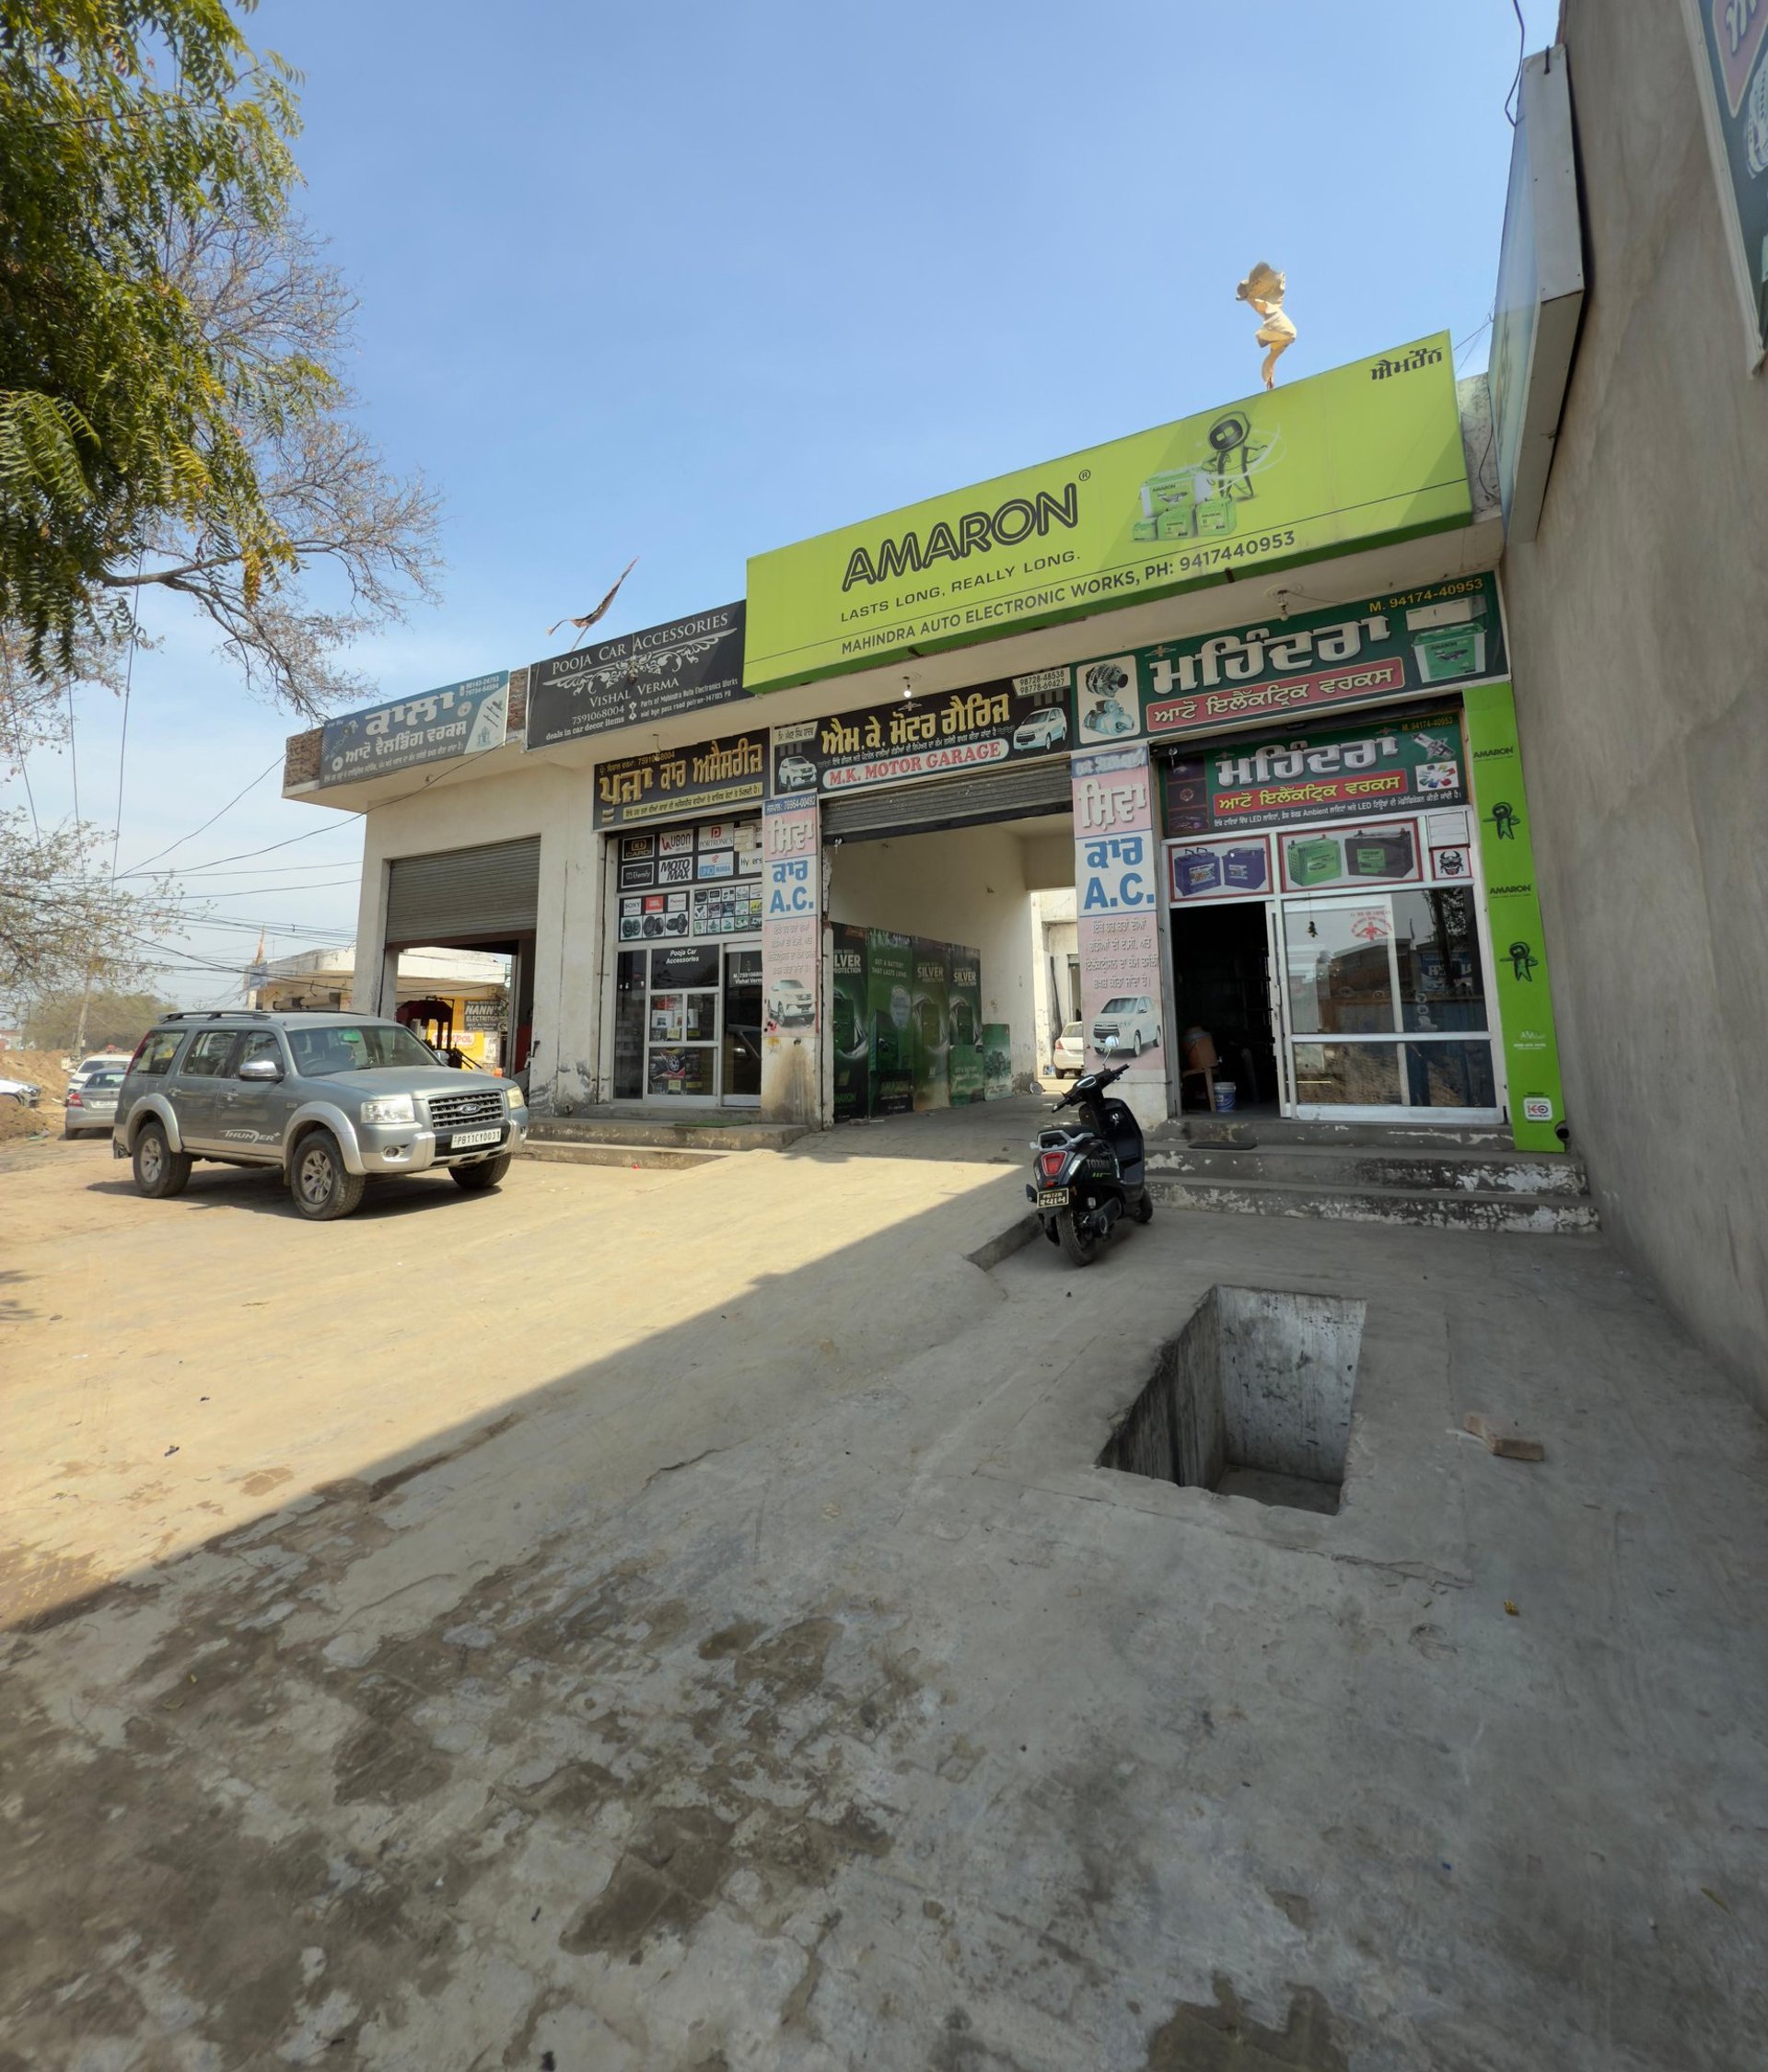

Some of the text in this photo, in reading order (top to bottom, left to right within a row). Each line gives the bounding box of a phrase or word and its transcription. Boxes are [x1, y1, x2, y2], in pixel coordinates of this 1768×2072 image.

[842, 483, 1078, 592] AMARON
[841, 550, 1081, 623] LASTS LONG, REALLY LONG.
[842, 530, 1296, 655] MAHINDRA AUTO ELECTRONIC WORKS, PH: 9417440953
[1369, 578, 1483, 613] M. 94174-40953
[552, 612, 728, 675] POOJA CAR ACCESSORIES
[1149, 615, 1391, 695] ਮਹਿੰਦਰਾ
[589, 678, 680, 708] VISHAL VERMA
[1018, 670, 1065, 687] 98728-48538
[1018, 678, 1065, 694] 98778-69427
[1154, 699, 1197, 723] ਆਟੋ
[1319, 667, 1394, 694] ਵਰਕਸ
[545, 716, 625, 741] deals in car decor items
[572, 704, 625, 725] 7591068004
[890, 711, 936, 745] ਮੋਟਰ
[345, 739, 371, 763] ਆਟੋ
[426, 721, 468, 743] ਵਰਕਸ
[1473, 746, 1514, 760] AMARON
[660, 760, 687, 791] ਕਾਰ
[829, 740, 1002, 786] M.K. MOTOR GARAGE
[1215, 736, 1400, 787] ਮਹਿੰਦਰਾ
[1219, 794, 1253, 810] ਆਟੋ
[1344, 776, 1401, 795] ਵਰਕਸ
[1250, 814, 1262, 823] LED
[1303, 808, 1329, 817] Ambient
[1357, 802, 1371, 810] LED
[660, 858, 691, 873] MOTO
[1084, 836, 1144, 869] ਕਾਰ
[667, 867, 691, 881] MAX
[772, 860, 808, 884] ਕਾਰ
[770, 886, 814, 914] A.C.
[1083, 872, 1155, 910] A.C.
[1489, 884, 1532, 895] AMARON
[666, 955, 700, 965] Accessories
[670, 949, 686, 958] Pooja
[917, 966, 944, 978] SILVER
[953, 971, 976, 984] SILVER
[457, 1131, 500, 1146] PB11CY0031
